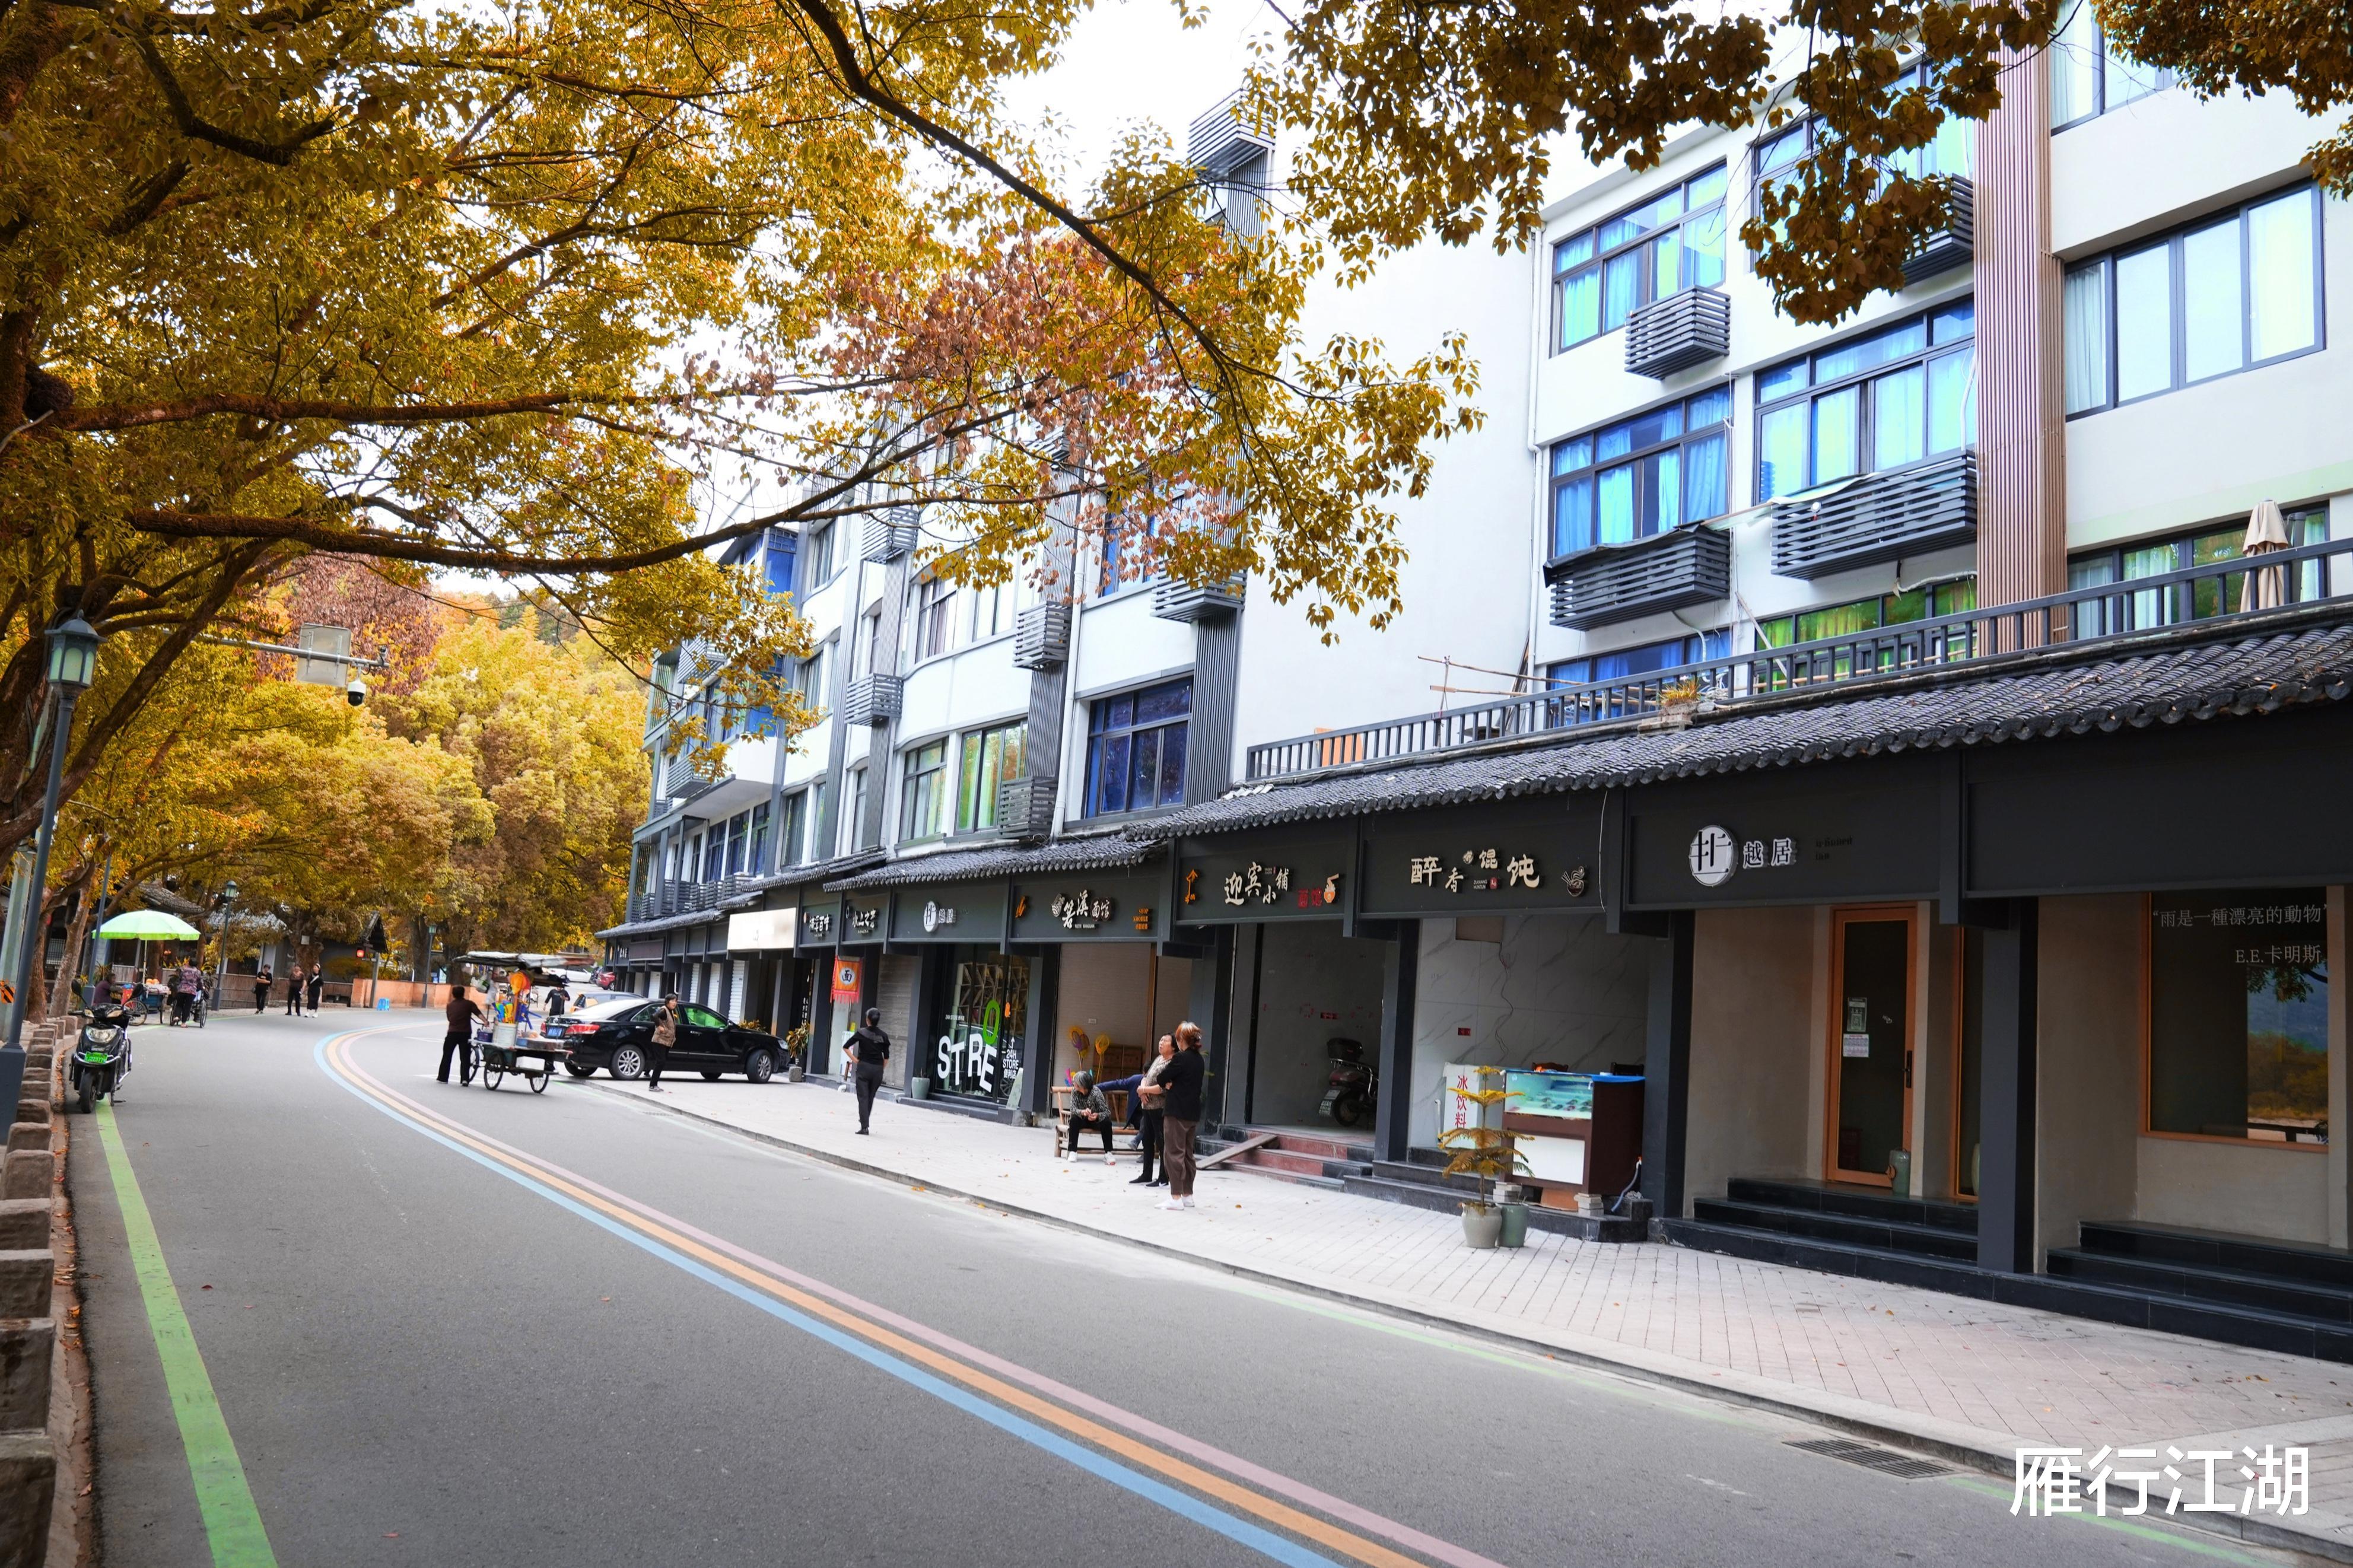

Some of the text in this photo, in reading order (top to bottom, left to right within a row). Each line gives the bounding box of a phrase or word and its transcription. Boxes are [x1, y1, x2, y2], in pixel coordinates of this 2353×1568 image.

[1742, 837, 1793, 869] 越居
[842, 969, 852, 982] 面
[1006, 1049, 1016, 1059] 24H
[1003, 1060, 1019, 1070] STORE
[1003, 1069, 1017, 1080] 便利店
